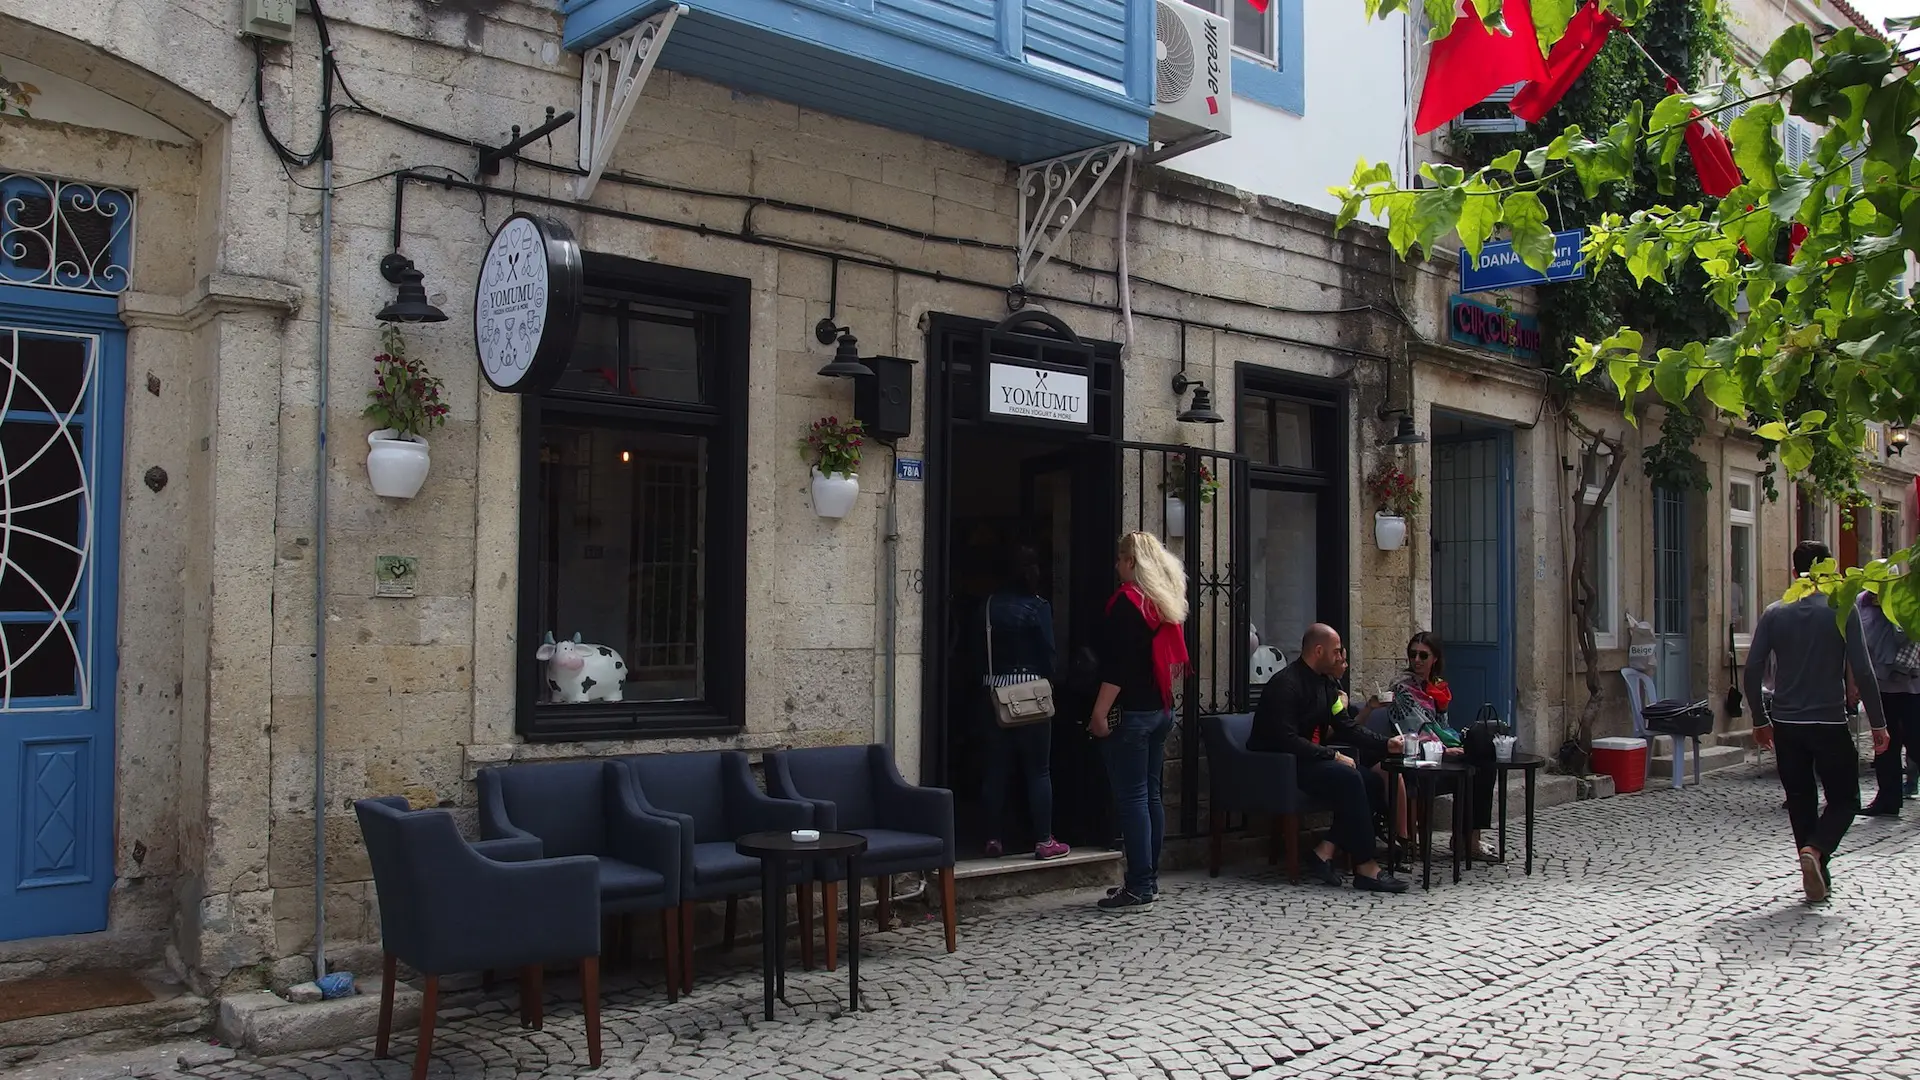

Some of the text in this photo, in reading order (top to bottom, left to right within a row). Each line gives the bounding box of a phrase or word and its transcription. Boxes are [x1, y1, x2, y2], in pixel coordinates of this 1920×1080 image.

[1204, 18, 1221, 94] arçelik
[490, 283, 535, 308] YOMUMU
[1001, 386, 1080, 413] YOMUMU
[1009, 406, 1030, 415] FROZEN
[1031, 408, 1052, 418] YOGURT
[1058, 412, 1072, 420] MORE
[900, 568, 924, 594] 78
[1631, 646, 1652, 655] Beige
